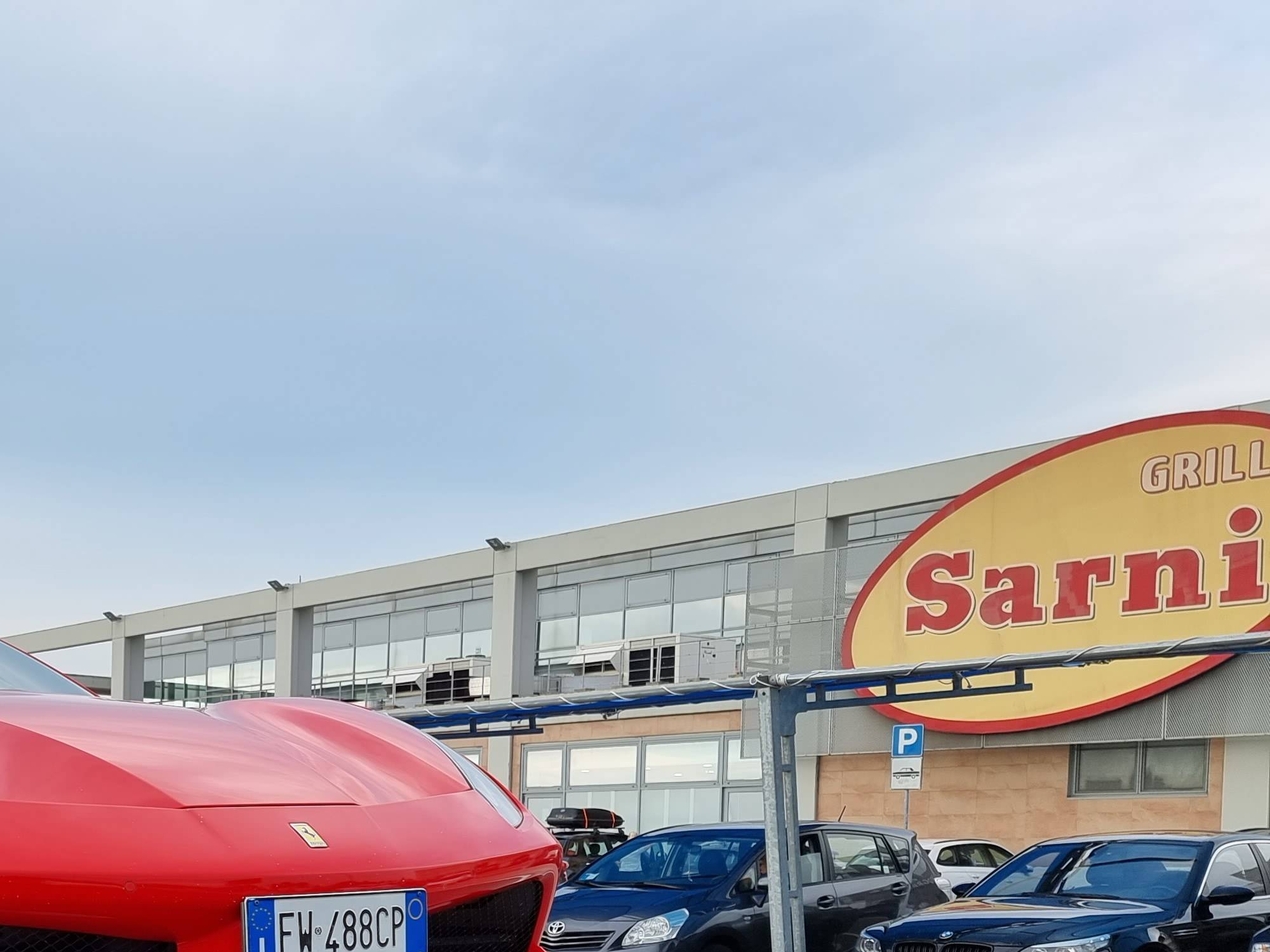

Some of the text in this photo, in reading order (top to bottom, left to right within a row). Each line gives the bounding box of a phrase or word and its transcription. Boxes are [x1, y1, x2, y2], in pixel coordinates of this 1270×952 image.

[1140, 439, 1270, 495] GRILL
[904, 503, 1270, 636] Sarni
[897, 728, 918, 755] P
